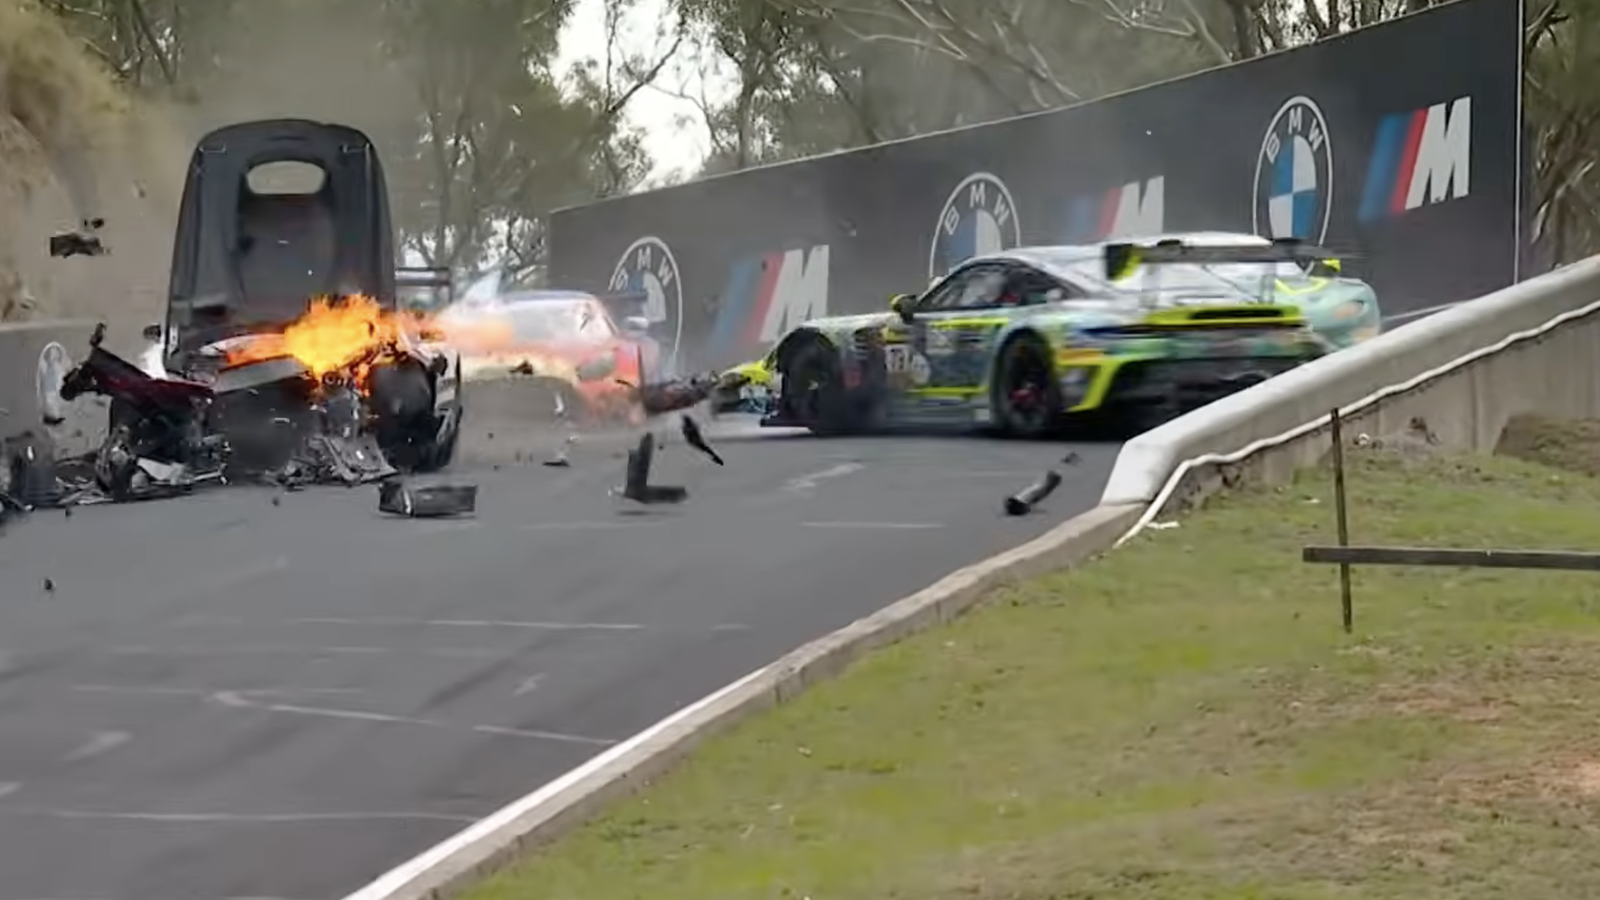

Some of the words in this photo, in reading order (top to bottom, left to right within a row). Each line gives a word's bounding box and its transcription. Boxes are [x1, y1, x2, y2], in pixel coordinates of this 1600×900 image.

[1266, 106, 1324, 164] BMW
[1405, 96, 1472, 211] M
[944, 181, 1010, 236] BMW
[759, 244, 830, 343] M
